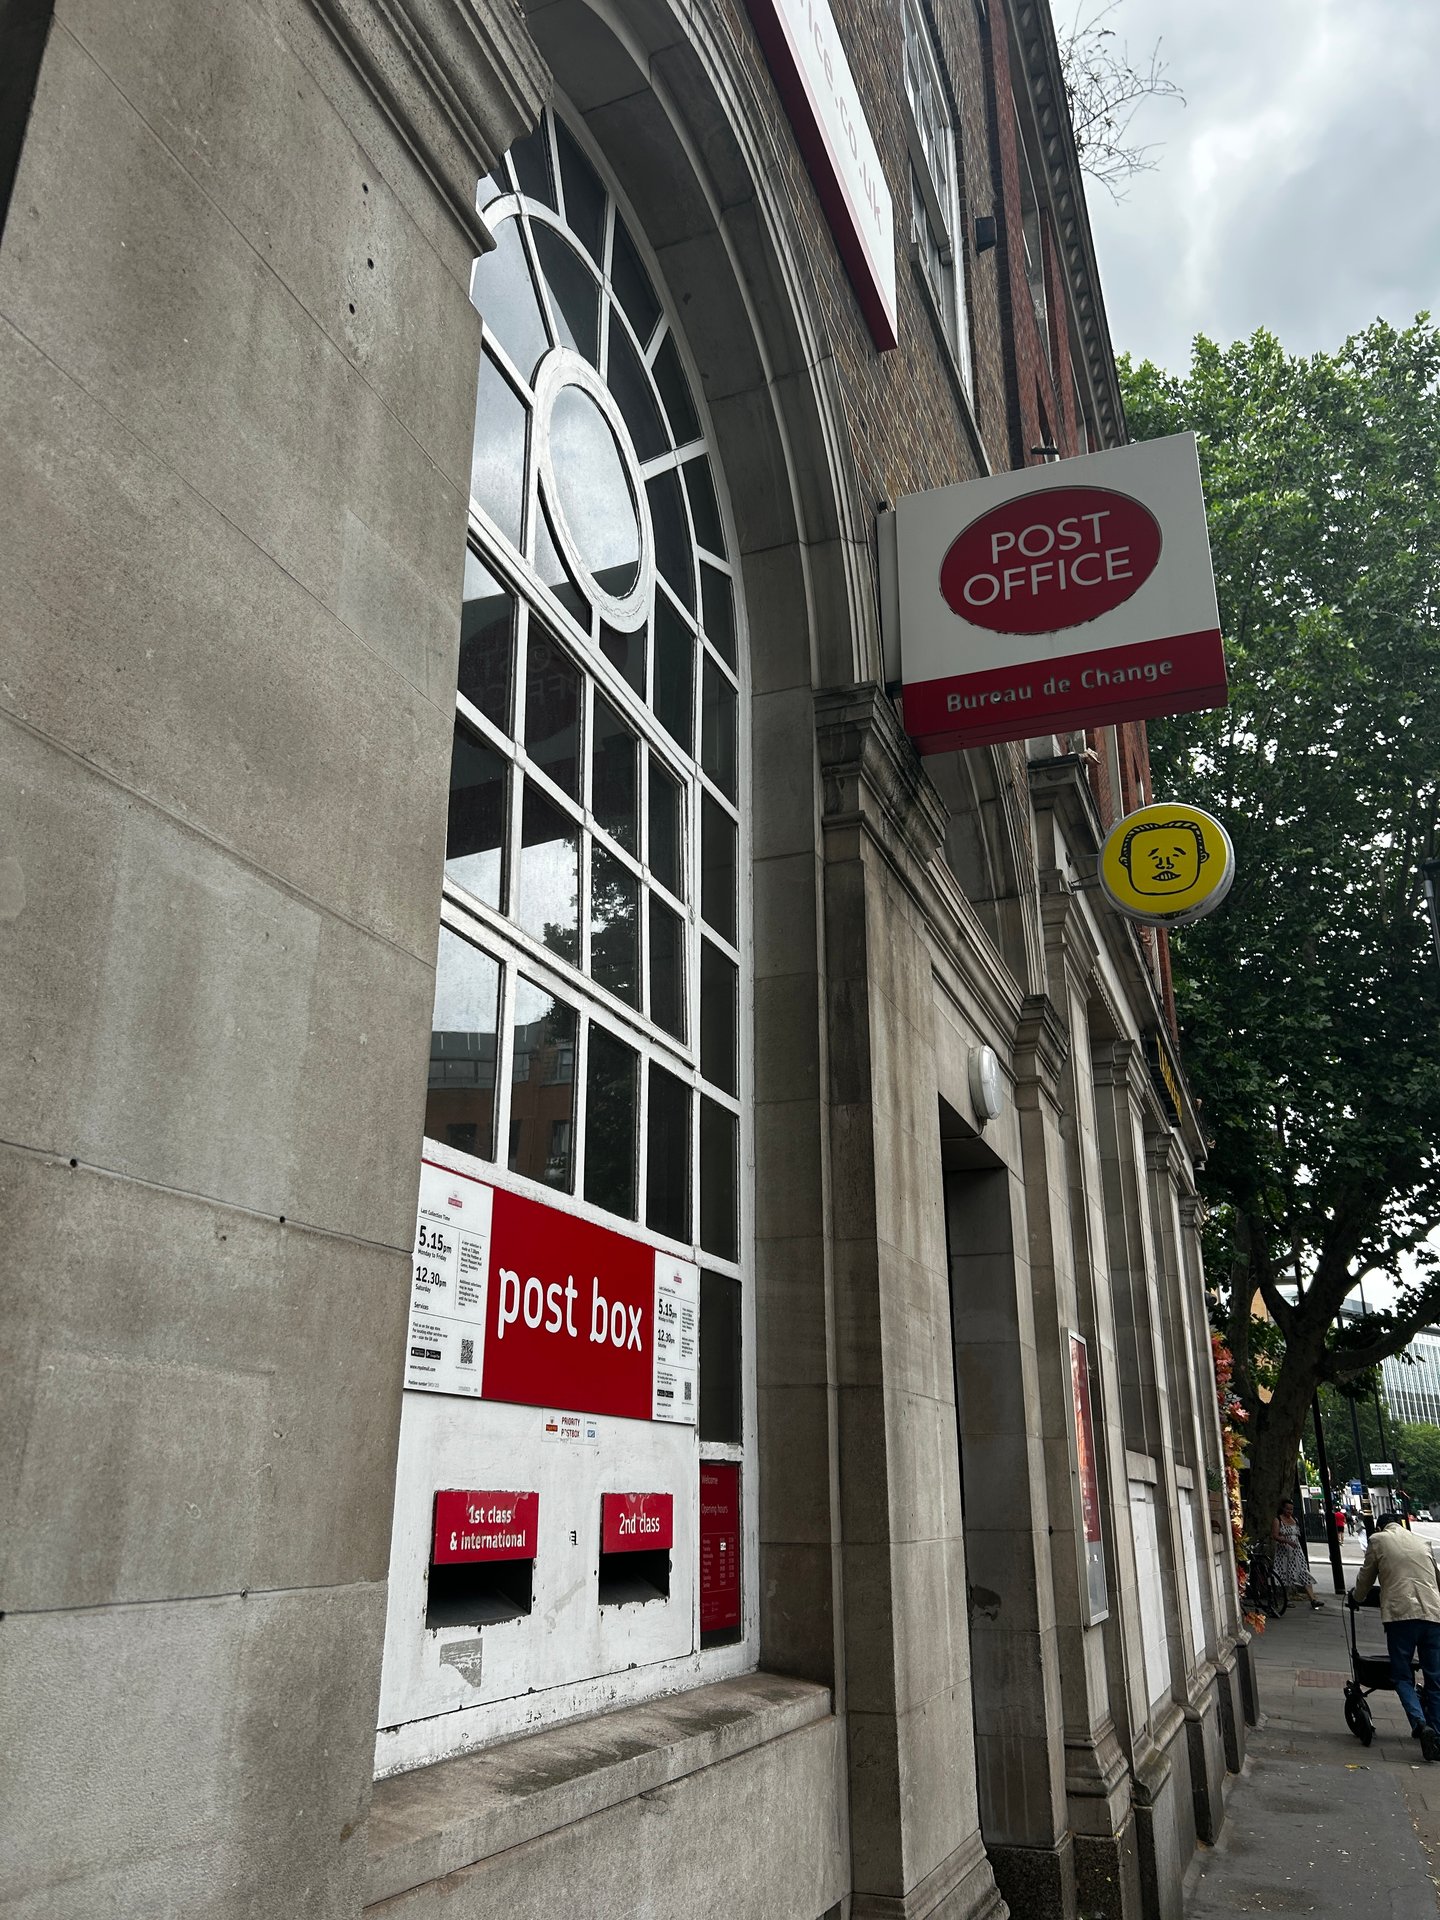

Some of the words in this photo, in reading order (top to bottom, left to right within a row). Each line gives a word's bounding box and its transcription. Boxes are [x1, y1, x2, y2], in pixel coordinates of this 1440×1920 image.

[990, 511, 1110, 564] POST
[963, 545, 1134, 606] OFFICE
[947, 685, 1033, 713] Bureau
[1043, 676, 1071, 697] de
[1081, 660, 1173, 688] Change
[418, 1225, 452, 1254] 5.15pm
[415, 1265, 447, 1287] 12.30pm
[497, 1267, 579, 1340] post
[590, 1277, 642, 1351] box
[658, 1298, 677, 1318] 5.15pm
[658, 1329, 675, 1344] 12.30pm
[561, 1416, 580, 1427] PRIORITY
[561, 1428, 580, 1438] PSTBOX
[468, 1505, 485, 1524] 1st
[487, 1506, 512, 1524] class
[619, 1513, 637, 1535] 2nd
[639, 1513, 660, 1533] class
[450, 1531, 458, 1551] &
[461, 1530, 526, 1550] international
